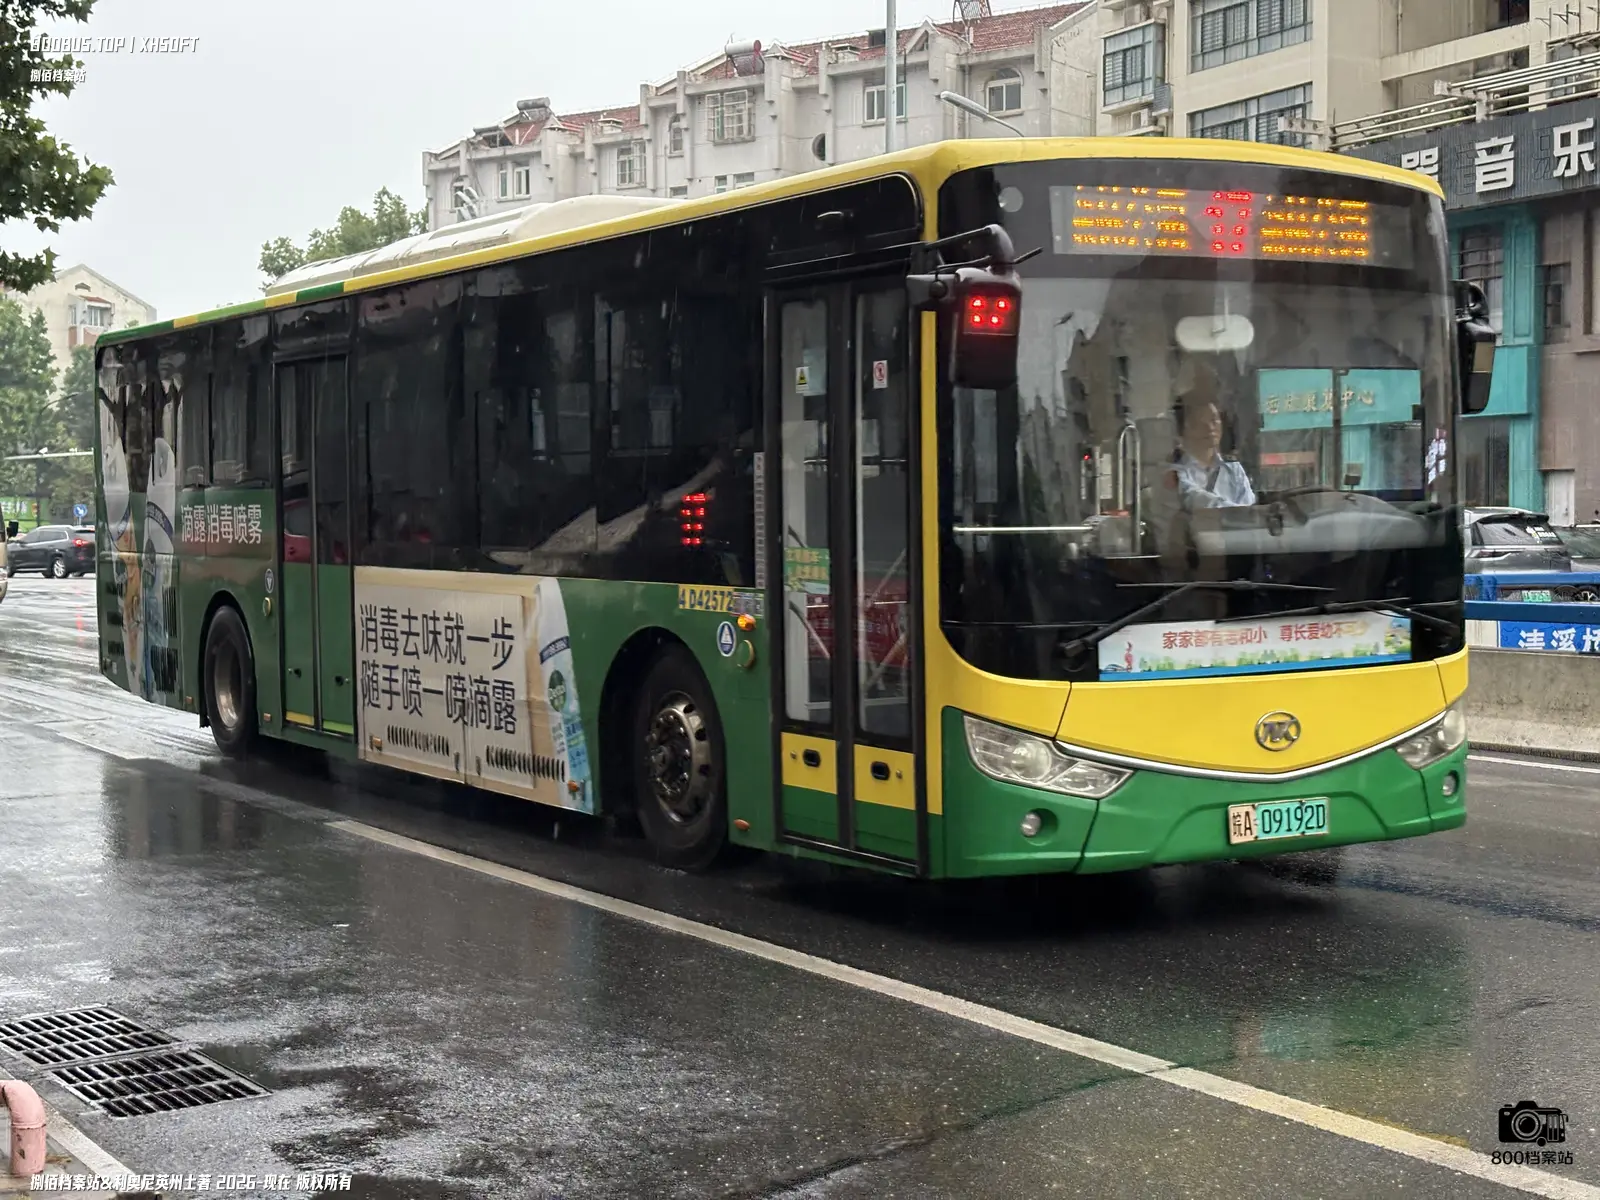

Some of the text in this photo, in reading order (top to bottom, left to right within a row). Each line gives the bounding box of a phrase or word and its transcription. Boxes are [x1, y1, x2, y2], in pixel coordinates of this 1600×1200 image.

[180, 504, 263, 545] 滴露消毒喷雾
[360, 604, 514, 670] 消毒去味就一步
[361, 659, 516, 734] 随手喷一喷滴露
